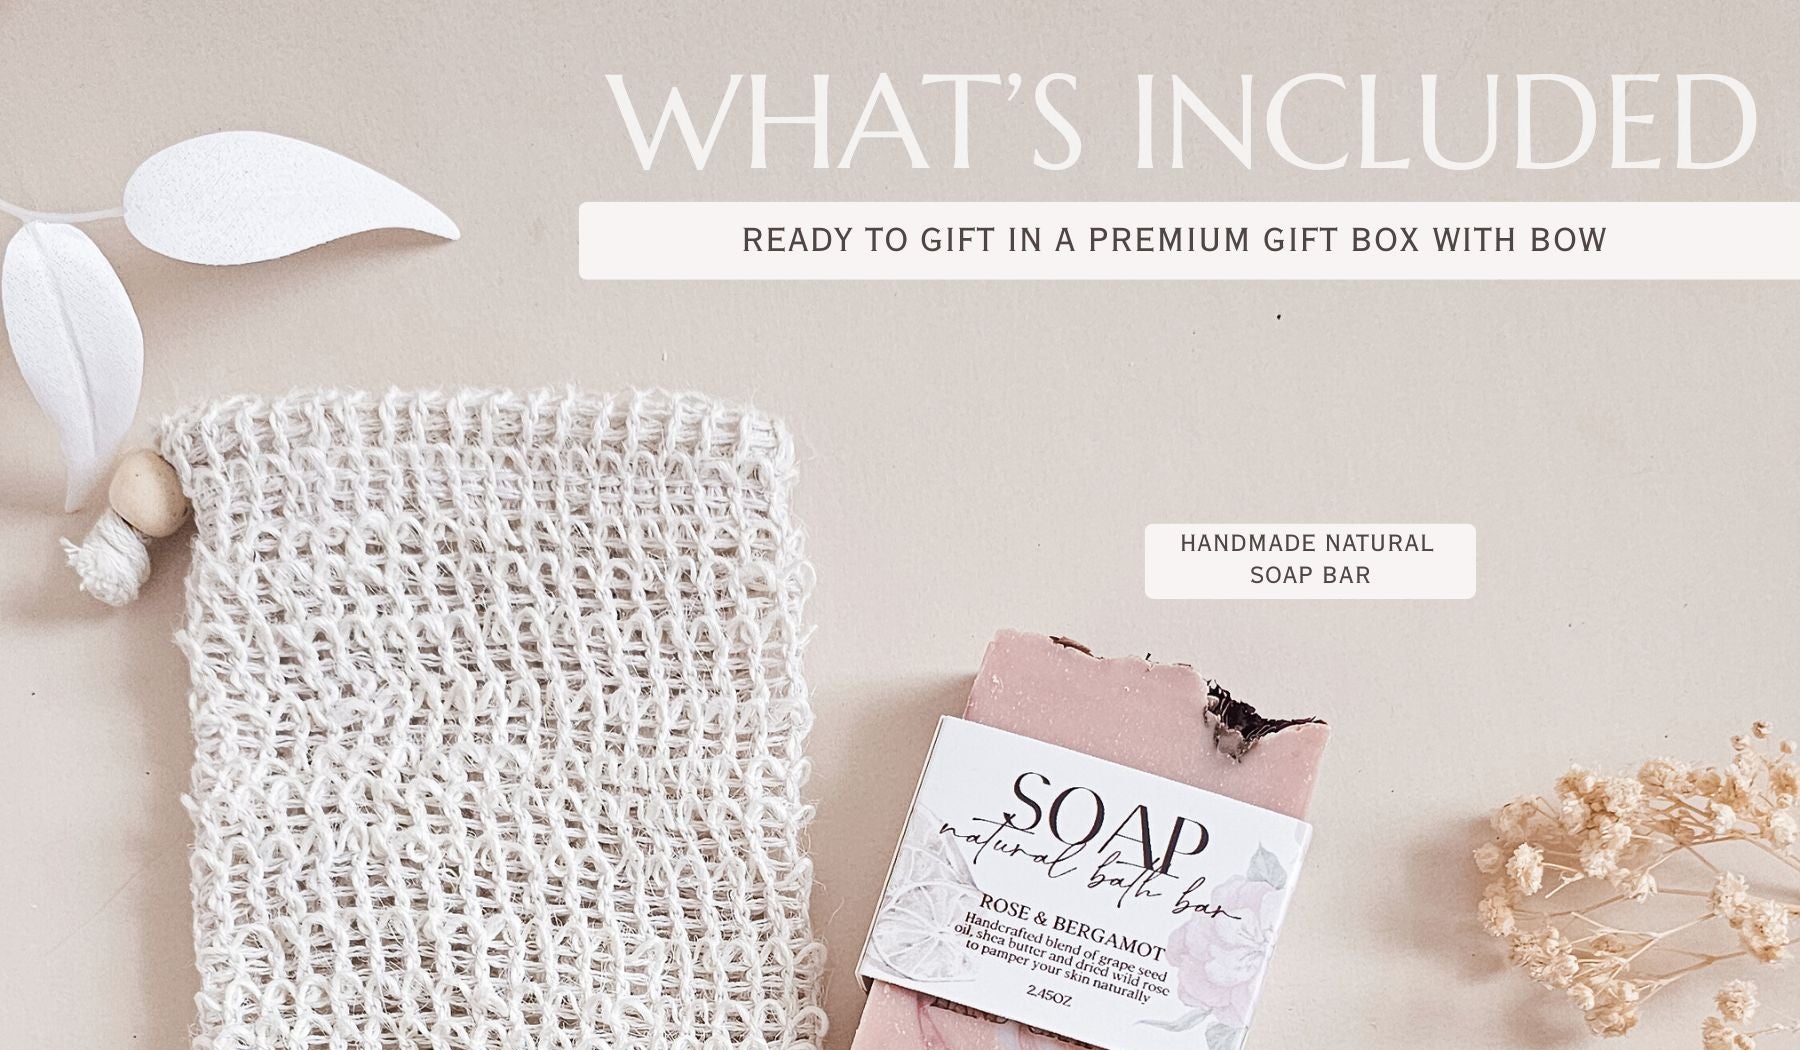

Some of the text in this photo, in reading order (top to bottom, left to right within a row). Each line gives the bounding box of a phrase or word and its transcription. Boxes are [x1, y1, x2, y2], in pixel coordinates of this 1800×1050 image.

[1003, 771, 1209, 875] SOAP
[940, 813, 1242, 920] natural bath bar
[954, 924, 1171, 997] oil, shea butter and dried wild rose
[965, 912, 1168, 982] Handcrafted blend of grape seed
[980, 893, 1166, 961] ROSE & BERGAMOT
[965, 939, 1151, 1004] to pamper your skin naturally
